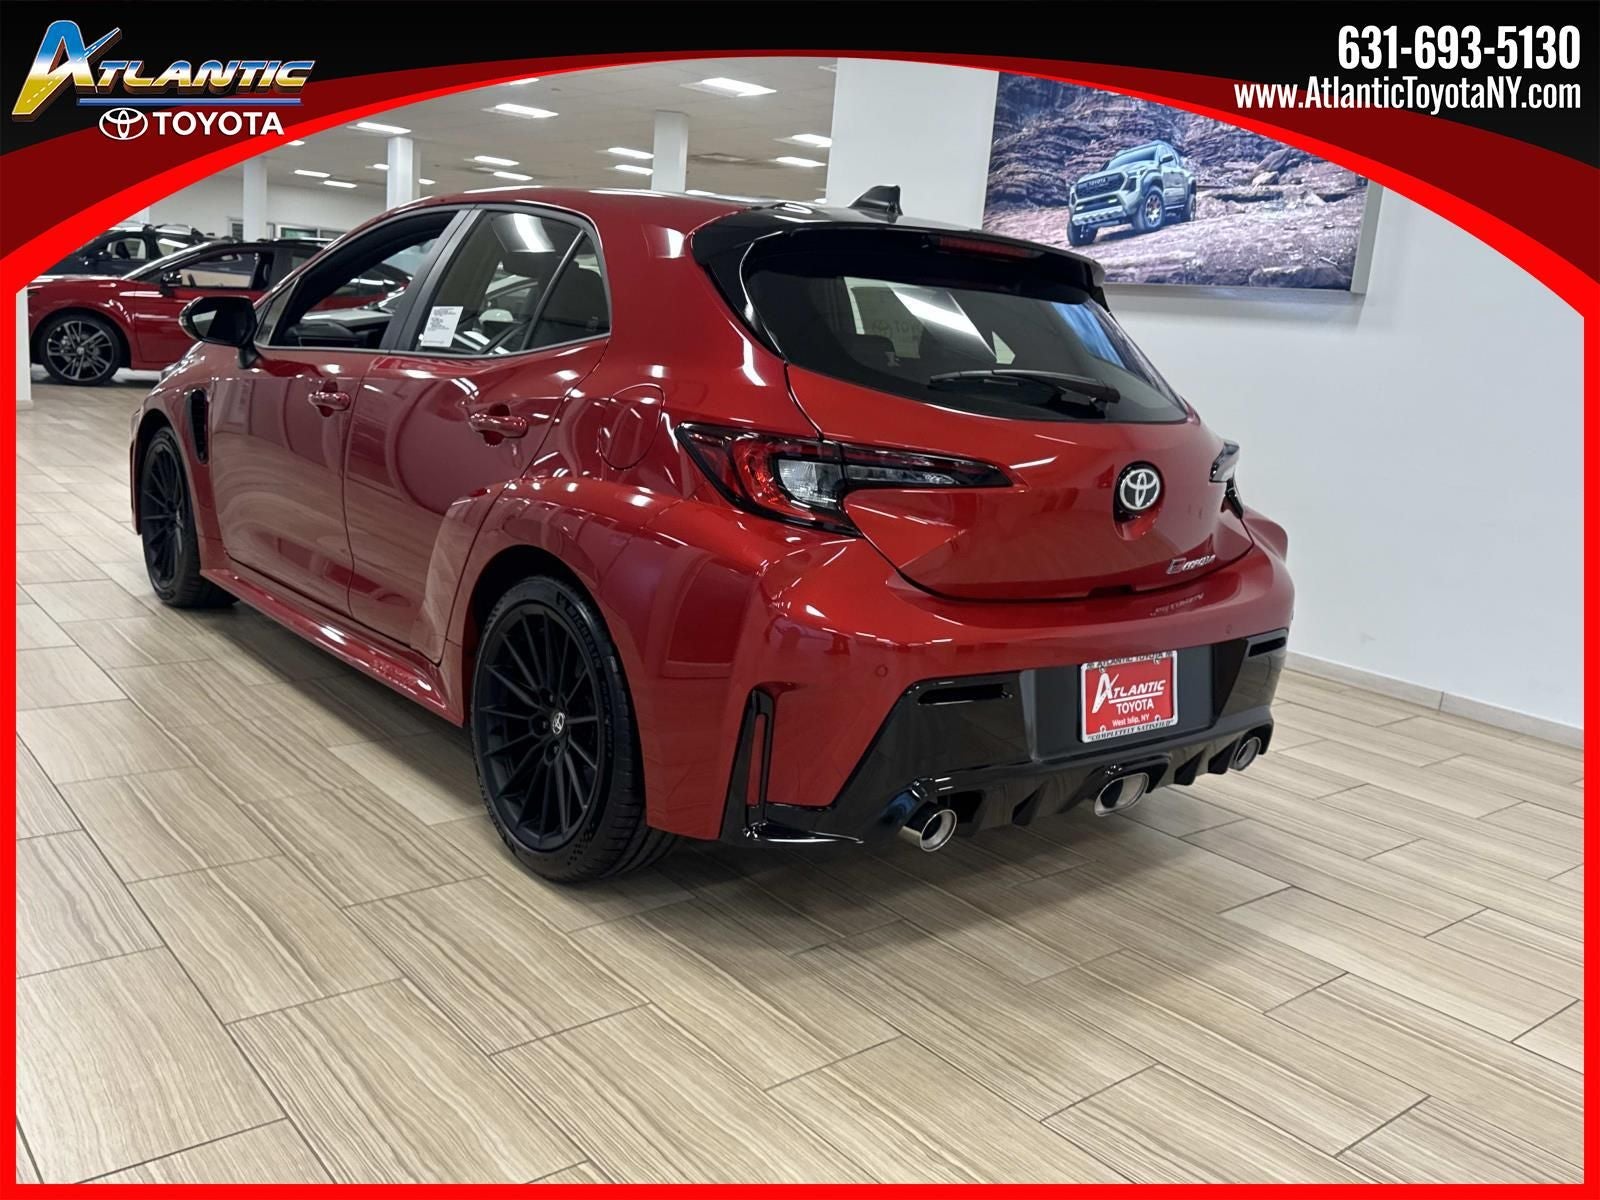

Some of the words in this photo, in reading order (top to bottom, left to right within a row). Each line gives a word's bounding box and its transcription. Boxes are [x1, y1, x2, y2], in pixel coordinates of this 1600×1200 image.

[1091, 672, 1166, 713] ATLANTIC
[1116, 698, 1154, 715] TOYOTA
[1112, 718, 1126, 727] West
[1141, 713, 1150, 721] NY
